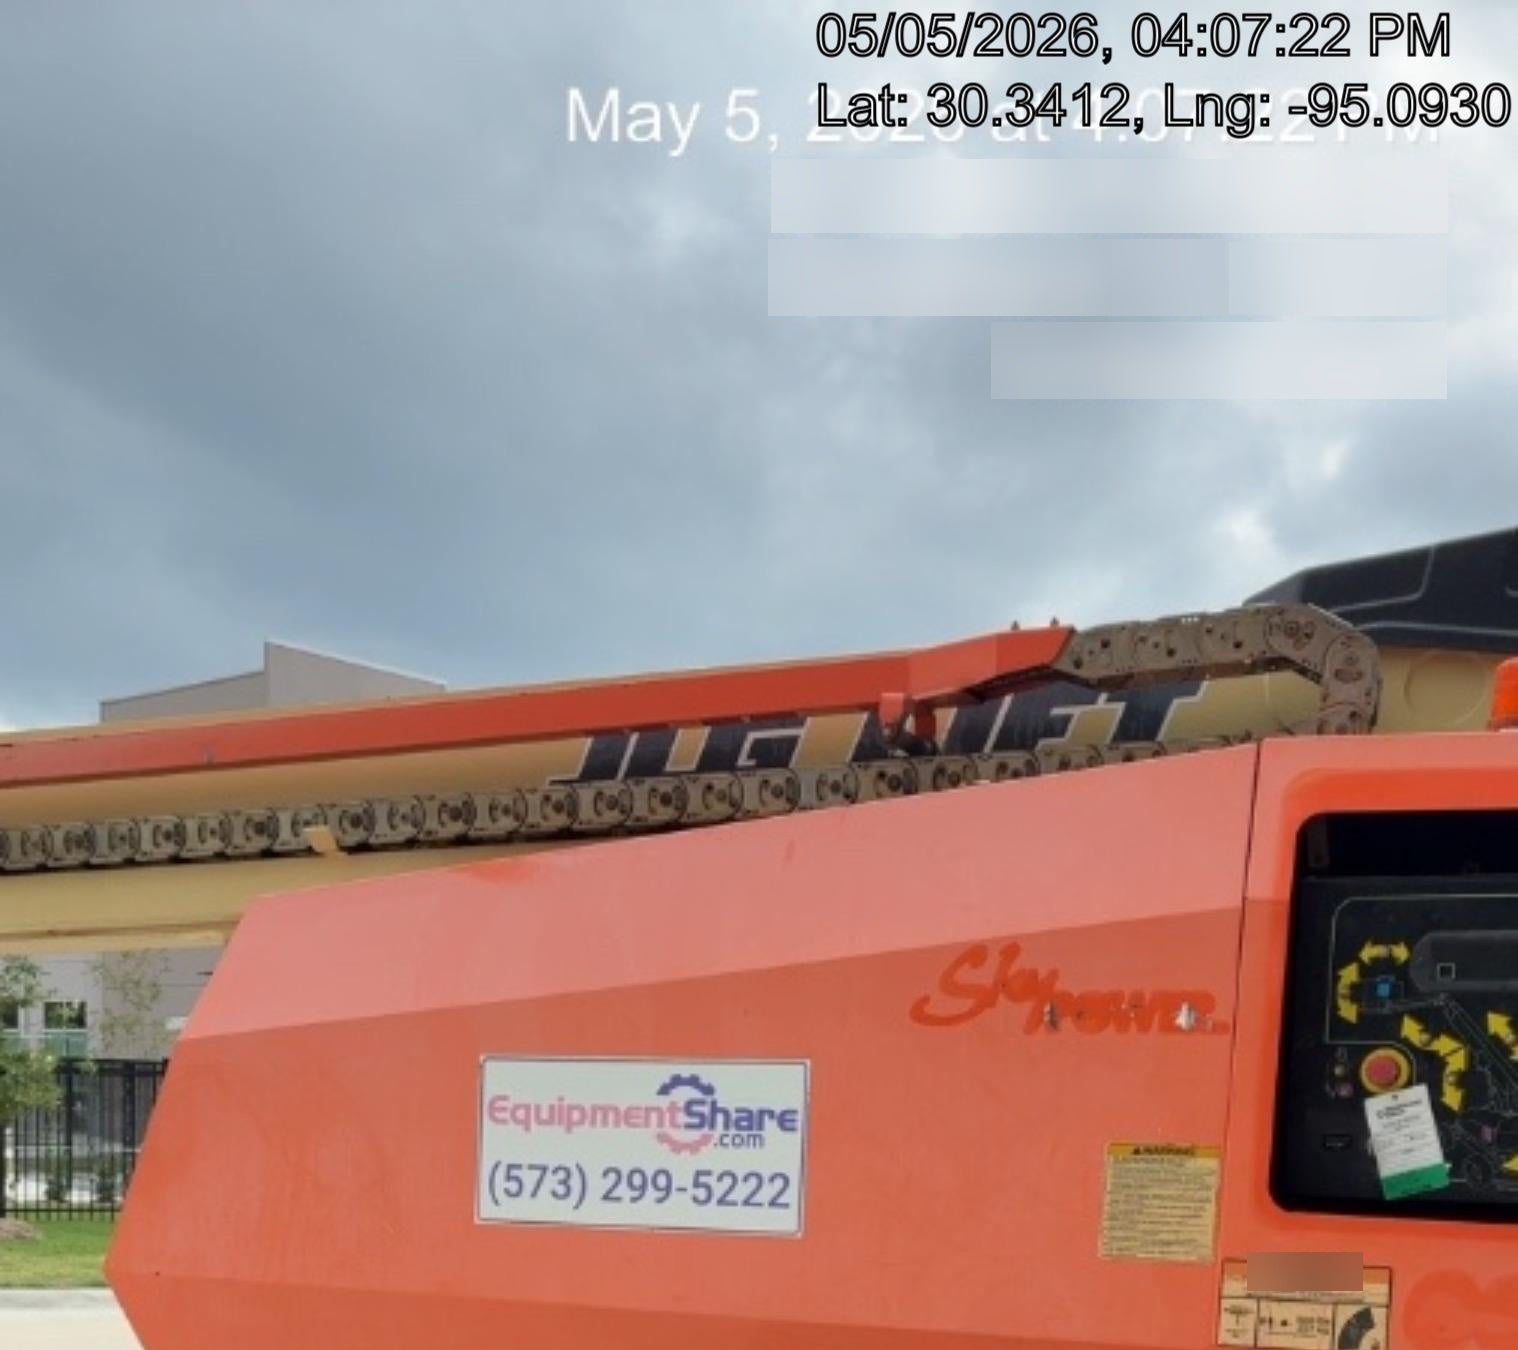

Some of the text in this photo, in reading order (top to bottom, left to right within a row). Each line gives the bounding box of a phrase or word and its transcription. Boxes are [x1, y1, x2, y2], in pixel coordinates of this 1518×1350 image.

[486, 1094, 799, 1134] EquipmentShare
[713, 1132, 765, 1149] .com
[487, 1160, 791, 1211] (573) 299-5222
